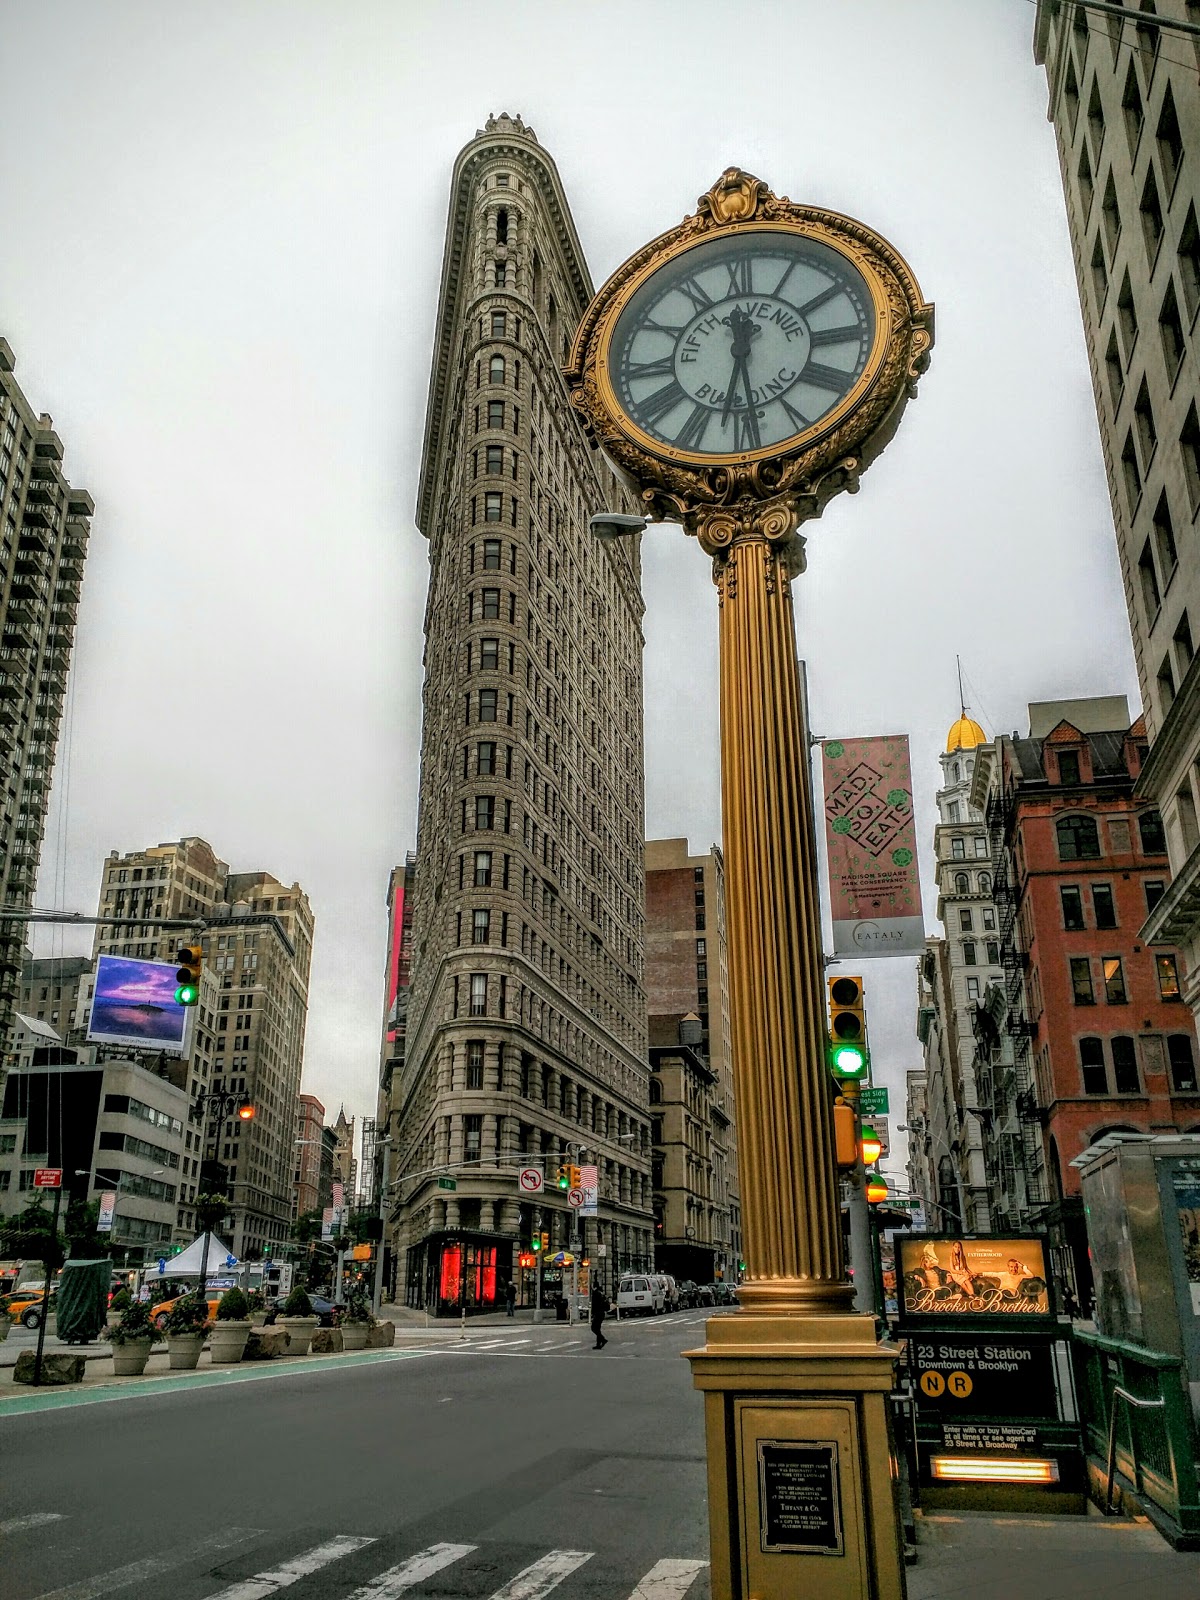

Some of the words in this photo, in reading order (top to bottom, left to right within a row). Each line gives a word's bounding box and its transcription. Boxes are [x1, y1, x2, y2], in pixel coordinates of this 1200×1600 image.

[681, 313, 722, 363] FIFTH
[734, 302, 804, 342] AVENUE
[694, 368, 797, 408] BULDING
[826, 776, 873, 816] MAD.
[865, 802, 911, 848] EATS
[859, 878, 907, 886] CONSERVANCY
[857, 931, 904, 940] EATALY
[860, 1097, 884, 1105] ighway
[905, 1286, 967, 1313] Brooks
[969, 1287, 1048, 1313] Brothers
[917, 1345, 934, 1358] 23
[939, 1346, 979, 1359] Street
[984, 1346, 1031, 1360] Station
[918, 1360, 965, 1370] Downtown
[968, 1361, 975, 1370] &
[978, 1360, 1018, 1372] Brooklyn
[927, 1376, 939, 1391] N
[954, 1377, 966, 1391] R
[987, 1427, 1000, 1435] buy
[1001, 1428, 1036, 1436] MetroCard
[985, 1441, 1018, 1450] Broadway
[1006, 1435, 1025, 1443] agent
